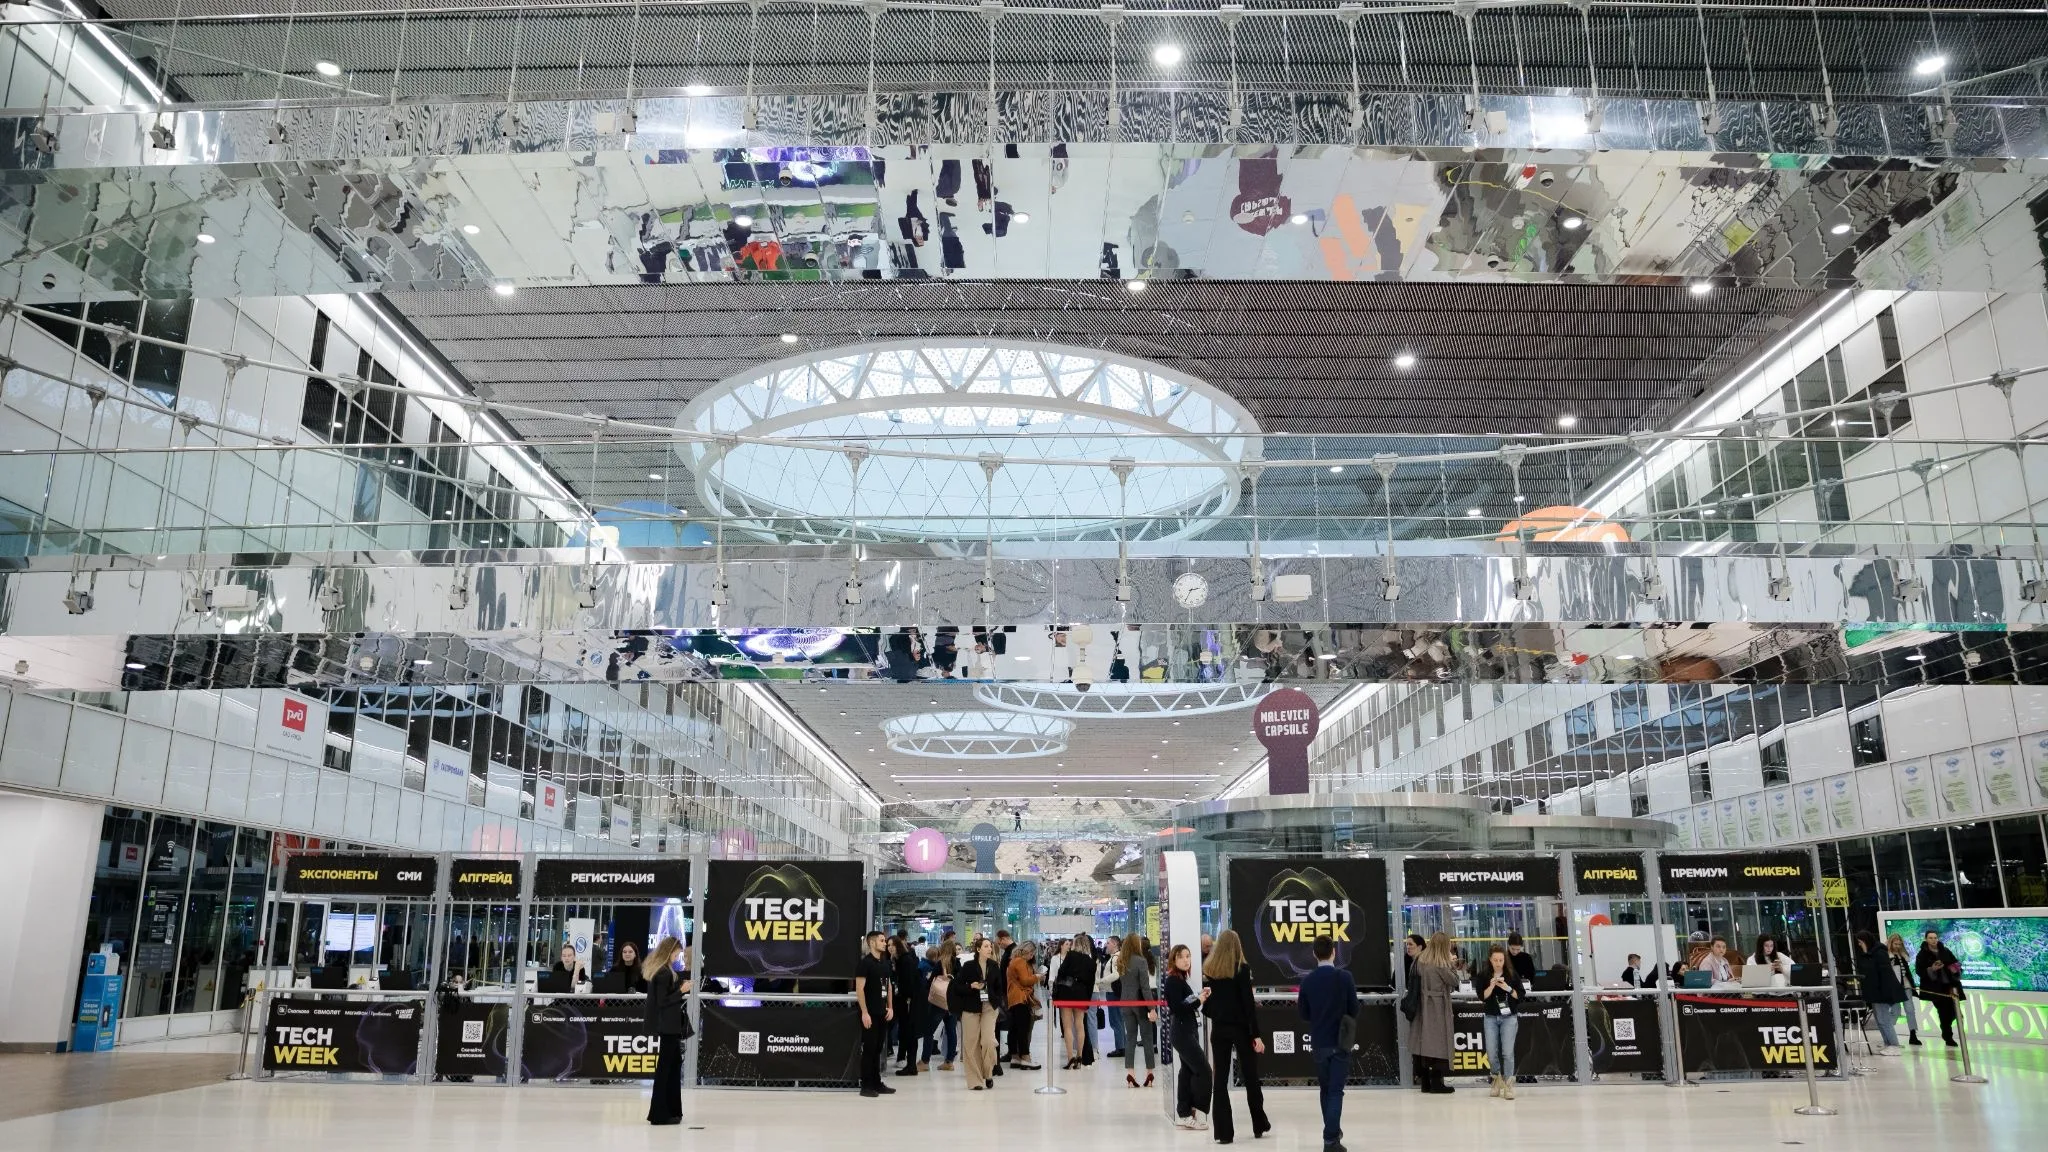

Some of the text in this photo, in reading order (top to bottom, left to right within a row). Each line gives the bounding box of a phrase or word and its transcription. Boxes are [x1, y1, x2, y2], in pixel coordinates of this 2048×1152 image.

[1260, 709, 1310, 723] MALEVICH
[1265, 723, 1309, 737] CAPSULE
[917, 838, 929, 861] 1
[299, 869, 423, 881] ЭКСПОНЕНТЫ СМИ
[458, 872, 513, 885] АПГРЕЙД
[571, 873, 655, 884] РЕГИСТРАЦИЯ
[1439, 871, 1524, 883] РЕГИСТРАЦИЯ
[1583, 867, 1638, 881] АПГРЕЙД
[1670, 866, 1801, 878] ПРЕМИУМ СПИКЕРЫ
[745, 898, 824, 921] TECH
[1269, 899, 1350, 922] TECH
[745, 921, 824, 941] WEEK
[1270, 922, 1351, 943] WEEK
[275, 1026, 333, 1045] TECH
[767, 1034, 810, 1044] Скачайте
[1454, 1032, 1483, 1050] CH
[603, 1035, 661, 1053] TECH
[766, 1045, 825, 1053] приложение
[273, 1045, 339, 1065] WEEK
[1453, 1052, 1491, 1070] EEK
